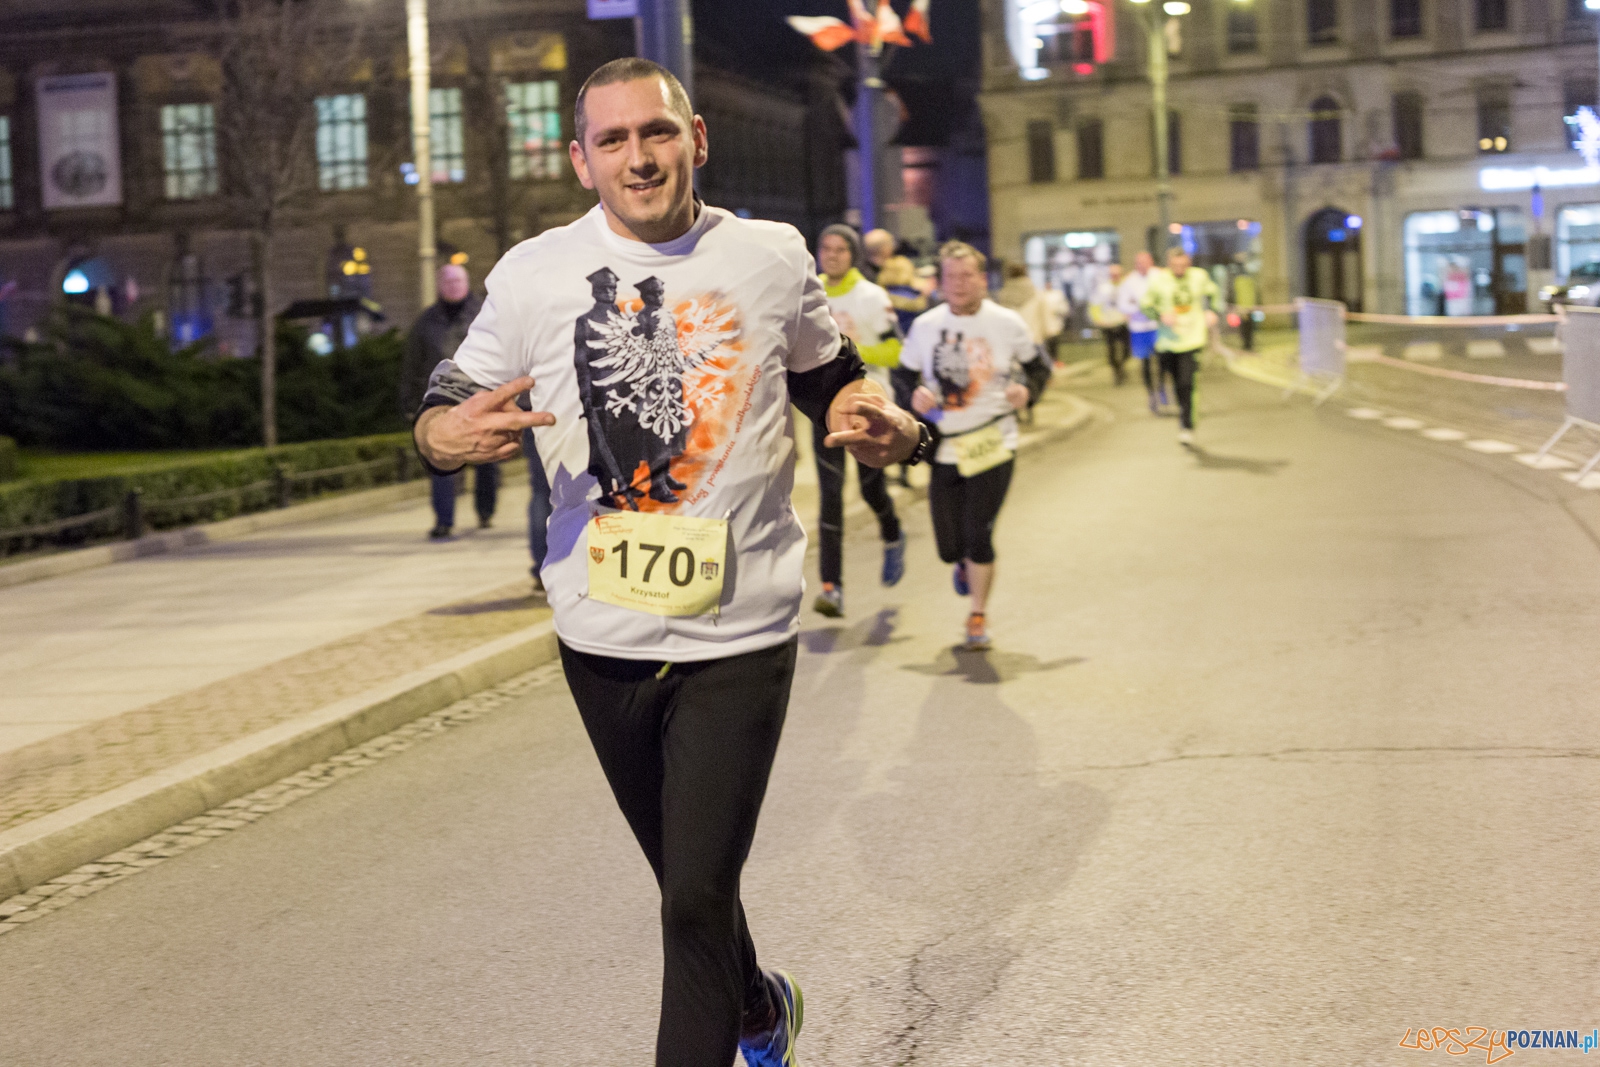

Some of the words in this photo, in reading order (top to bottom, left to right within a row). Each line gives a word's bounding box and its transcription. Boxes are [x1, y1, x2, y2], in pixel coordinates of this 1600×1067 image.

[687, 488, 709, 506] bieg
[706, 440, 736, 487] powstania
[612, 540, 695, 587] 170
[630, 586, 670, 599] Krzysztof
